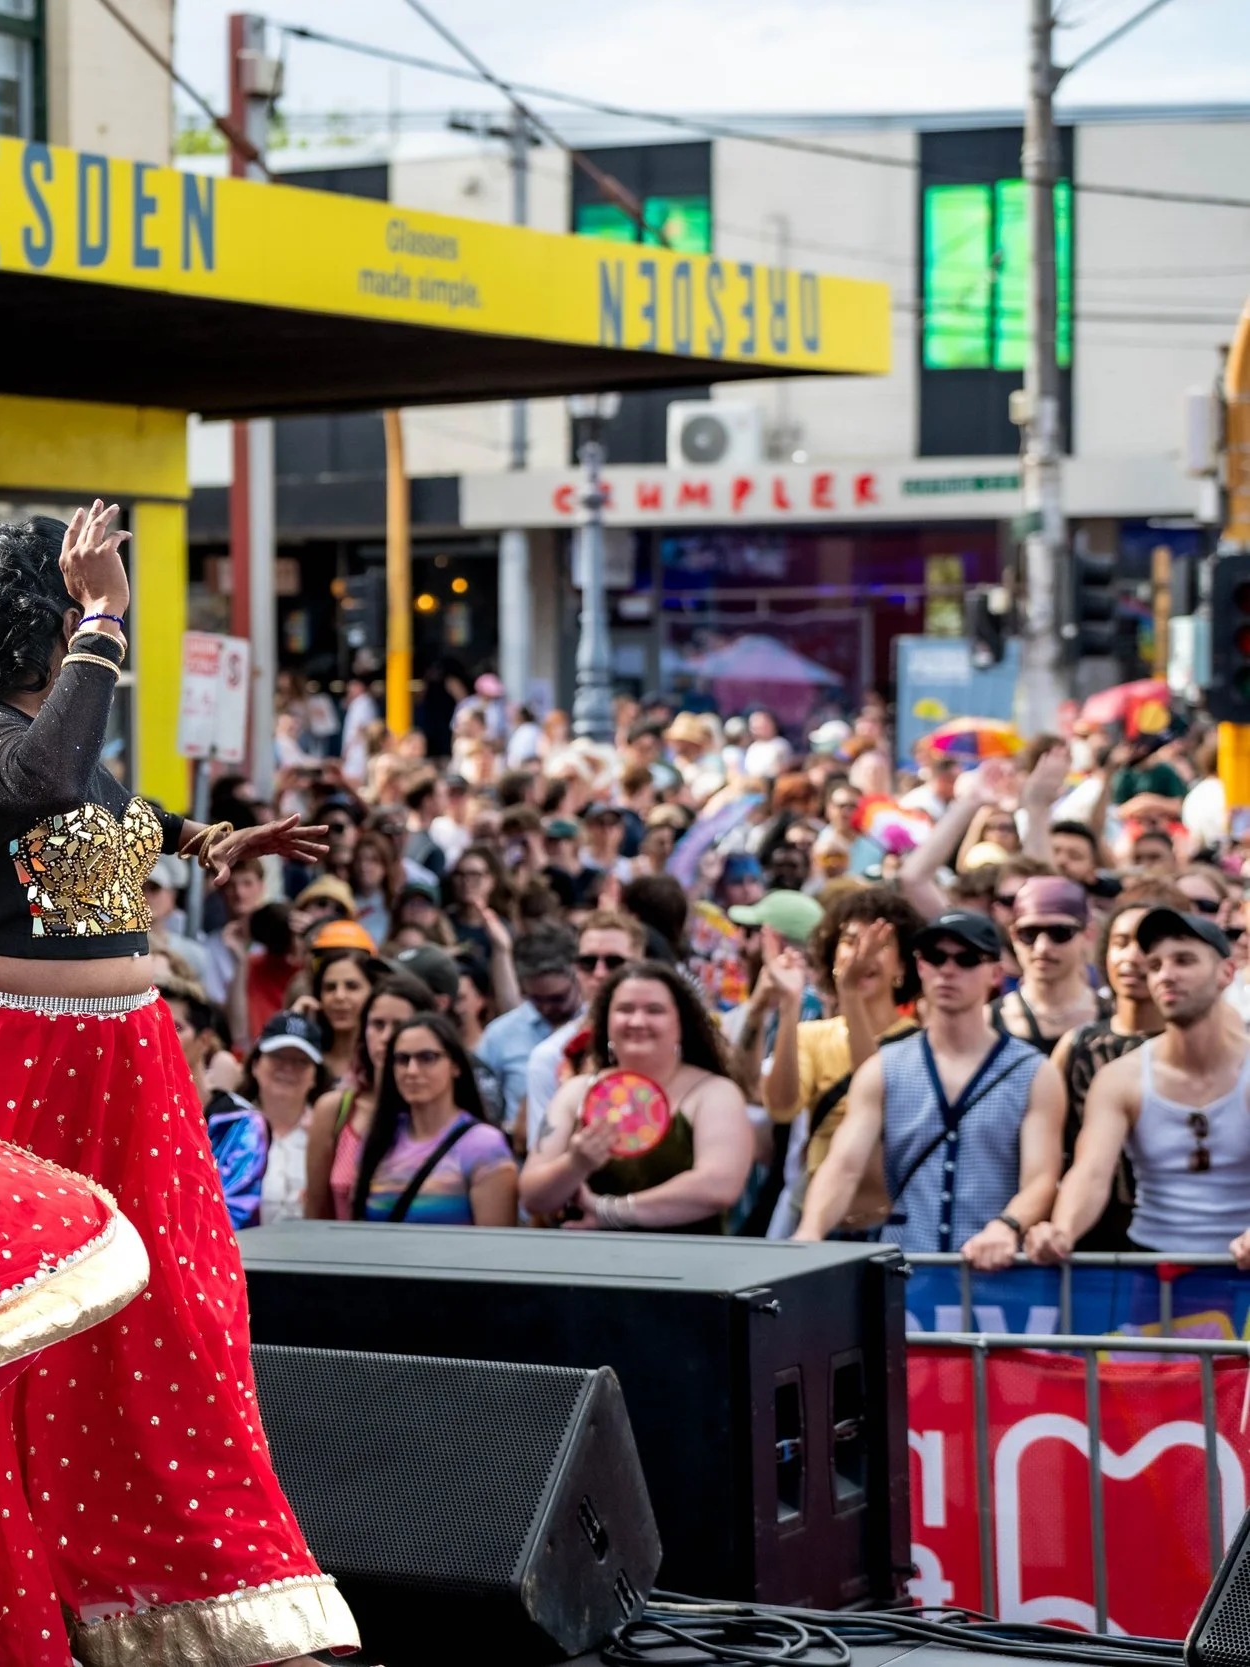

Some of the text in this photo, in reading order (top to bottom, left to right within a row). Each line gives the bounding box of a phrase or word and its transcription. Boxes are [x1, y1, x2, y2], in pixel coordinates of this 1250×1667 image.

[386, 218, 459, 262] Glasses
[358, 263, 411, 300] made
[598, 260, 820, 359] DRESDEN
